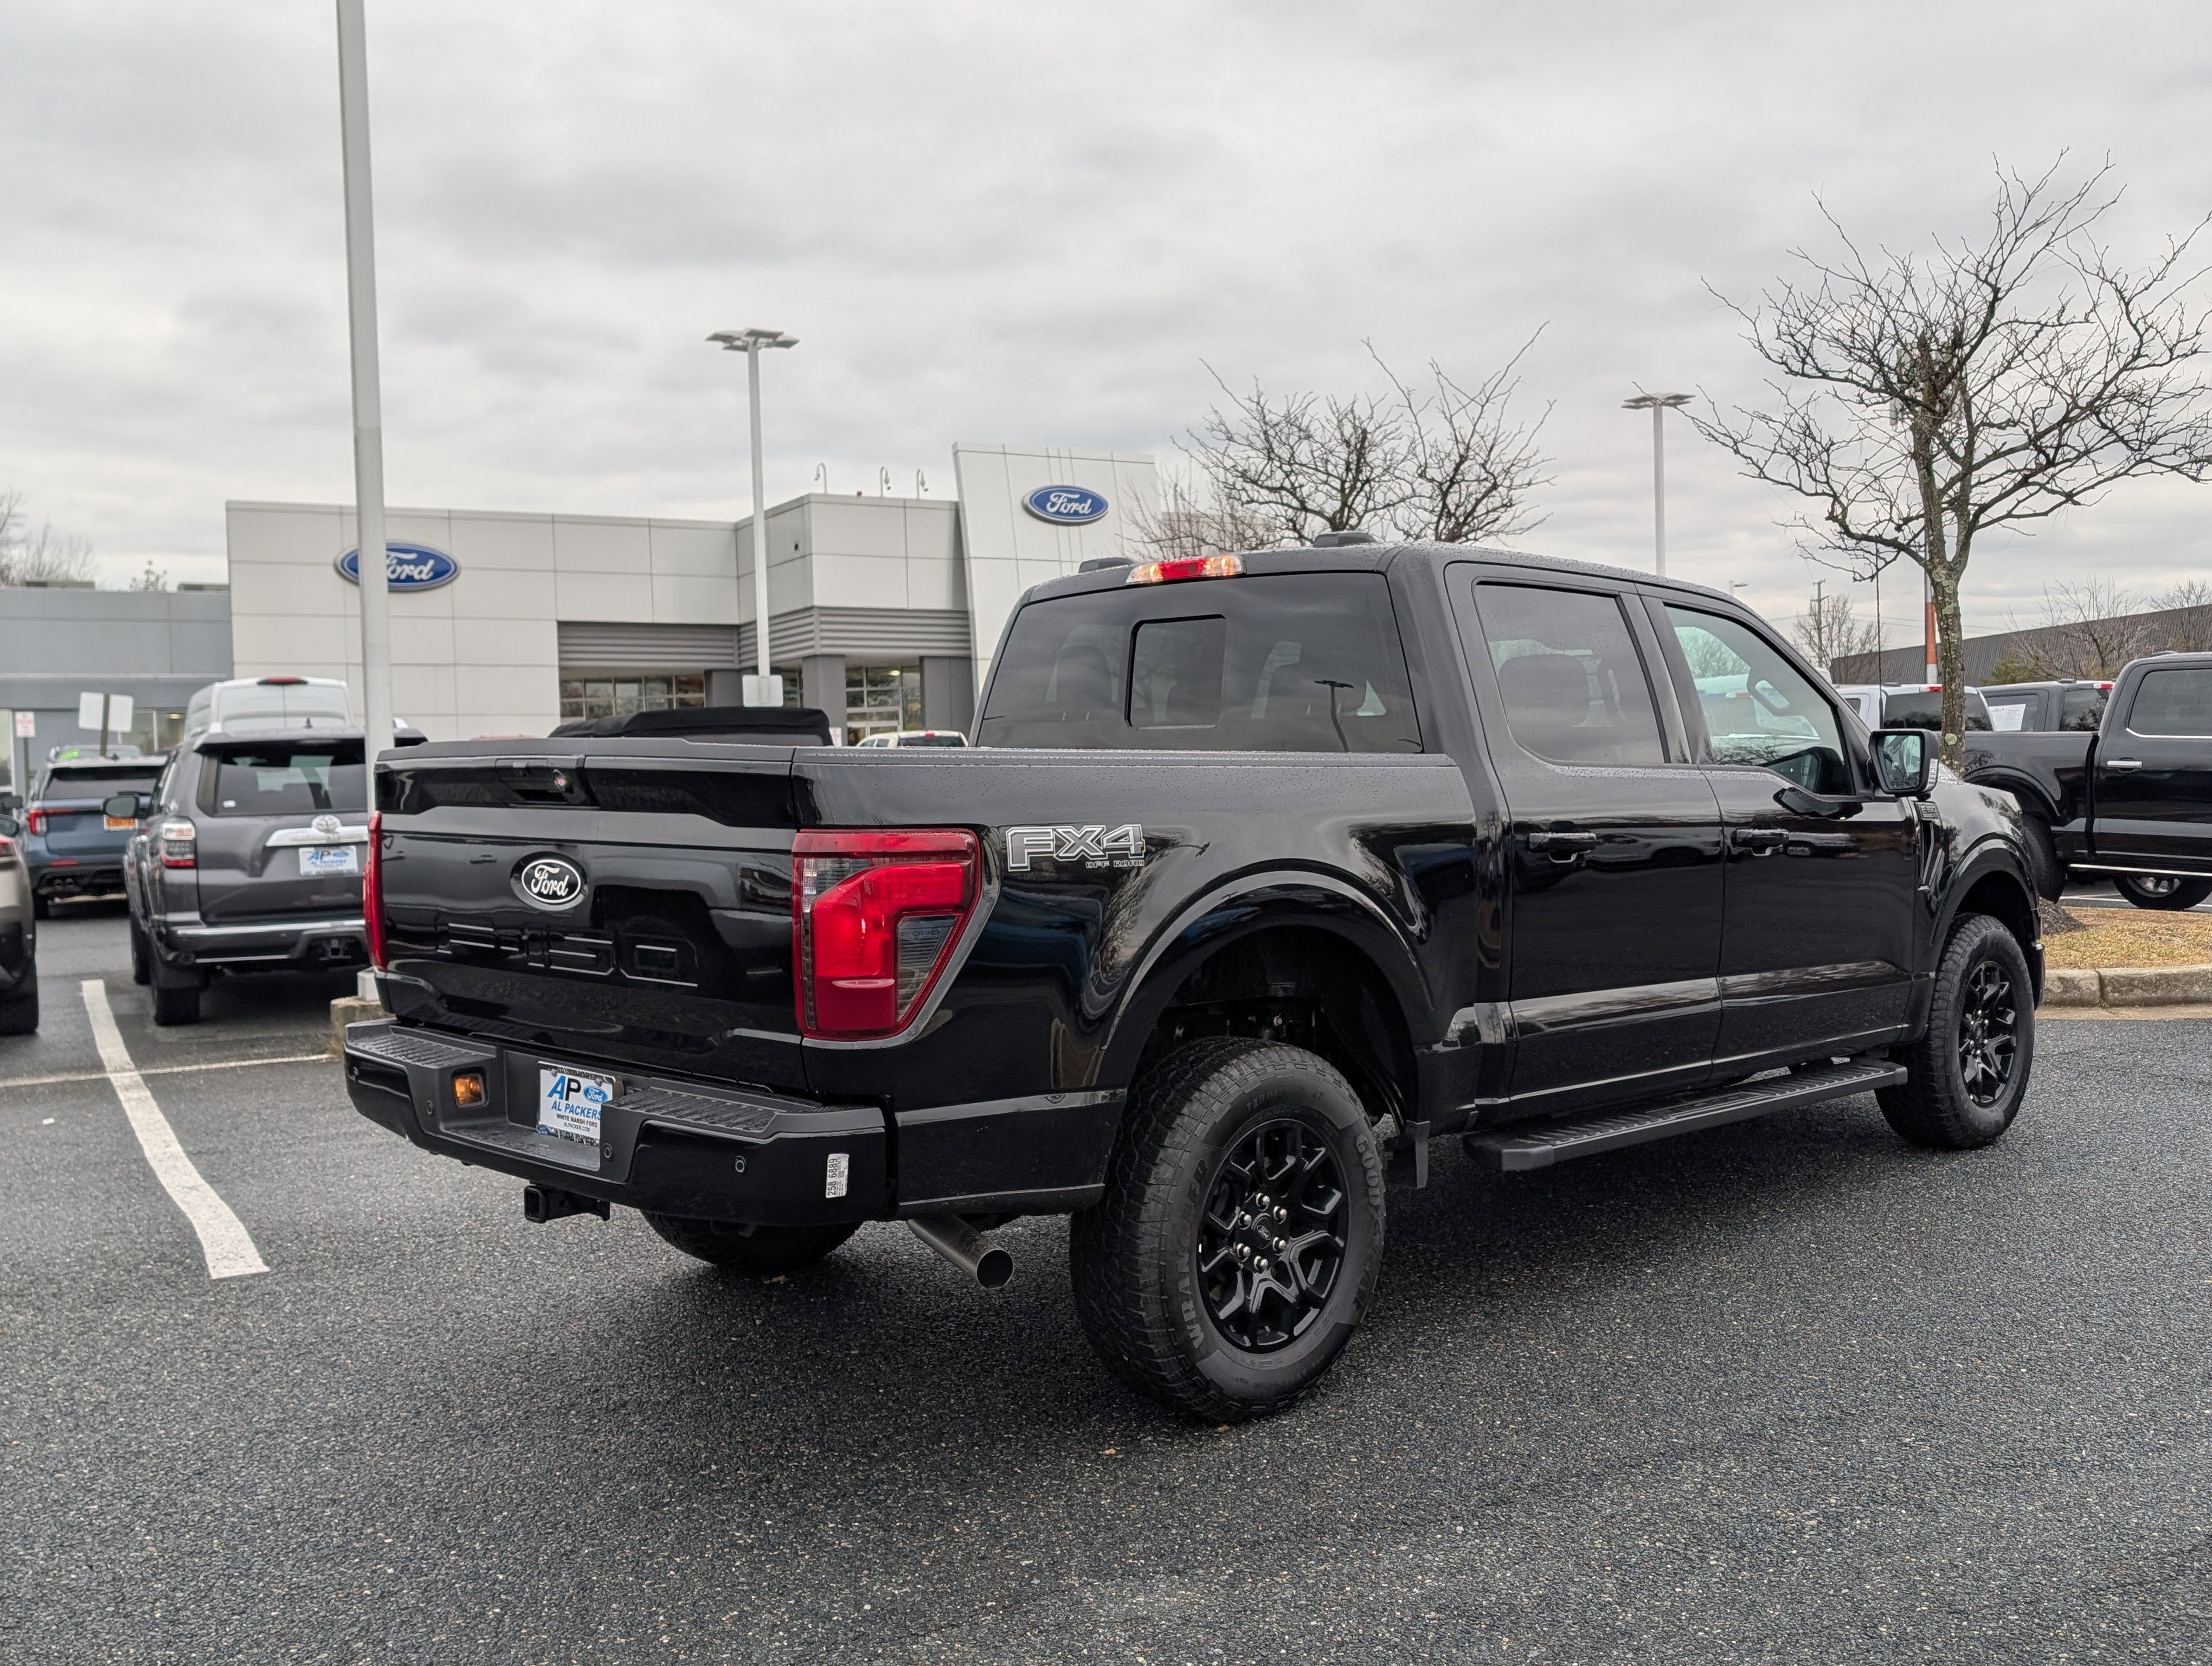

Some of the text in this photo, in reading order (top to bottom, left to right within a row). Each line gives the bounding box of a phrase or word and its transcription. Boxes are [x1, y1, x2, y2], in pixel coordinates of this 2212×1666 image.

[1045, 492, 1092, 514] Ford
[1006, 824, 1146, 872] FX4
[1085, 860, 1145, 869] OFF ROAD
[531, 864, 570, 896] Ford
[547, 1075, 582, 1101] AP
[587, 1087, 603, 1101] Ford
[551, 1100, 562, 1112] AL
[570, 1116, 586, 1125] MARSH
[586, 1120, 598, 1128] FORD
[827, 1158, 838, 1196] 258 6889
